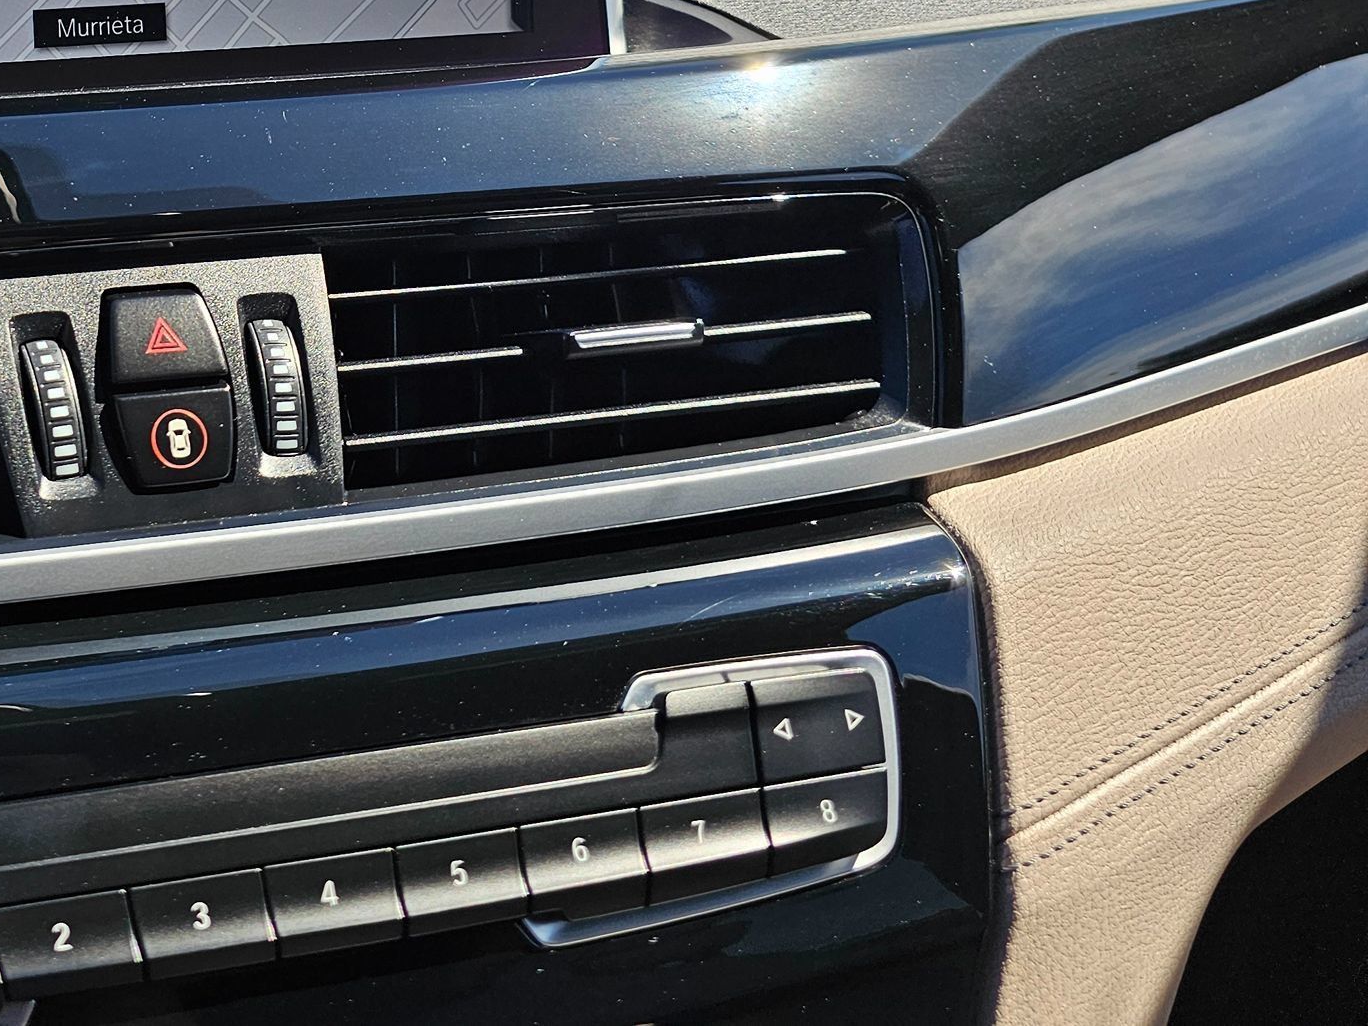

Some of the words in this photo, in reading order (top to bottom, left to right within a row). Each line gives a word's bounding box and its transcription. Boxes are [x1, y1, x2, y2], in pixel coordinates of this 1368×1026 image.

[57, 15, 144, 38] Murrieta
[819, 799, 838, 823] 8
[690, 819, 706, 844] 7
[571, 837, 589, 862] 6
[449, 859, 469, 886] 5
[320, 879, 339, 906] 4
[190, 901, 211, 930] 3
[50, 922, 74, 952] 2
